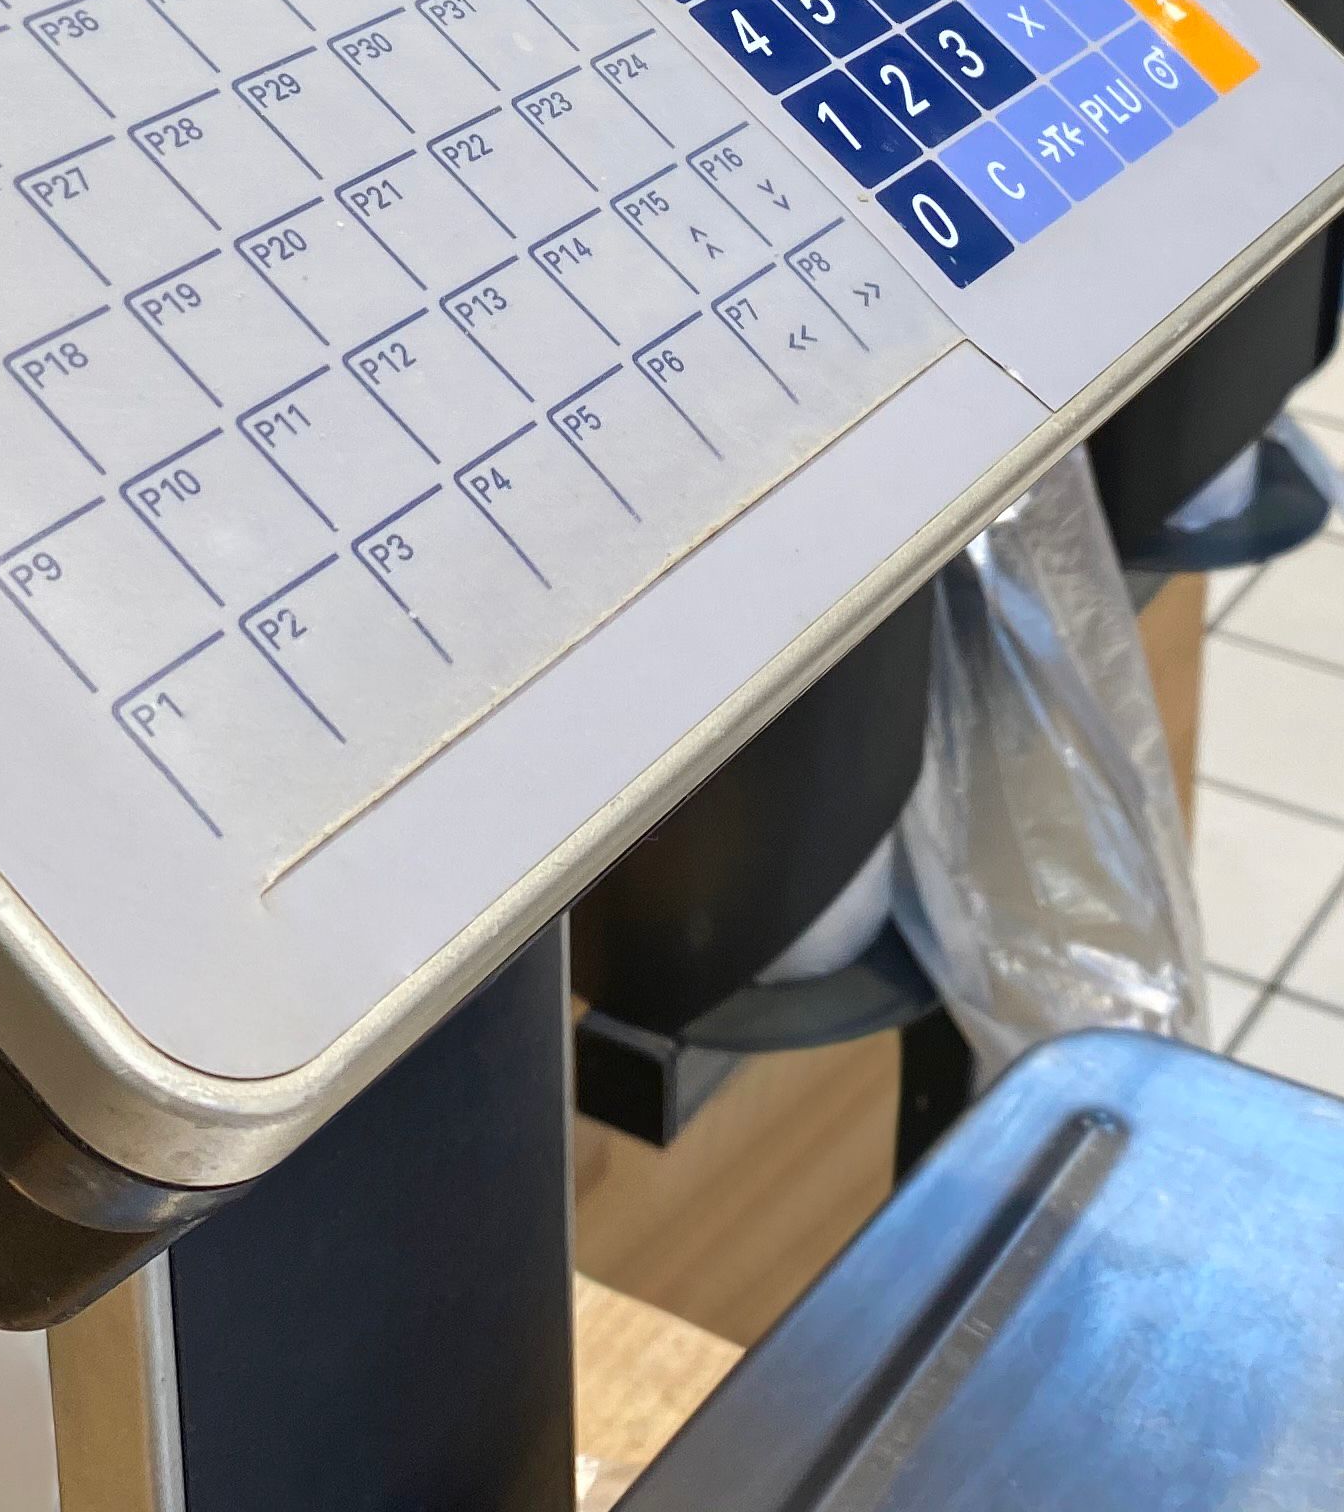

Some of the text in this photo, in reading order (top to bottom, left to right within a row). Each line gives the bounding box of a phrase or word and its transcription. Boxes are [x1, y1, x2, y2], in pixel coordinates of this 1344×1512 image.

[40, 11, 100, 45] P36
[730, 9, 773, 56] 4
[818, 101, 862, 150] 1
[879, 64, 930, 117] 2
[938, 29, 984, 78] 3
[32, 168, 90, 207] P27
[146, 117, 203, 155] P28
[248, 74, 301, 108] P29
[343, 33, 393, 65] P30
[912, 193, 959, 248] 0
[987, 162, 1026, 200] C
[1079, 78, 1142, 135] PLU
[21, 343, 89, 389] P18
[143, 284, 202, 325] P19
[252, 229, 308, 268] P20
[351, 179, 404, 216] P21
[442, 135, 493, 168] P22
[526, 92, 572, 125] P23
[604, 54, 648, 83] P24
[8, 148, 744, 597] P9 P10 P11 P12 P13 P14 P15 P16
[132, 251, 832, 736] P1 P2 P3 P4 P5 P6 P7 P8
